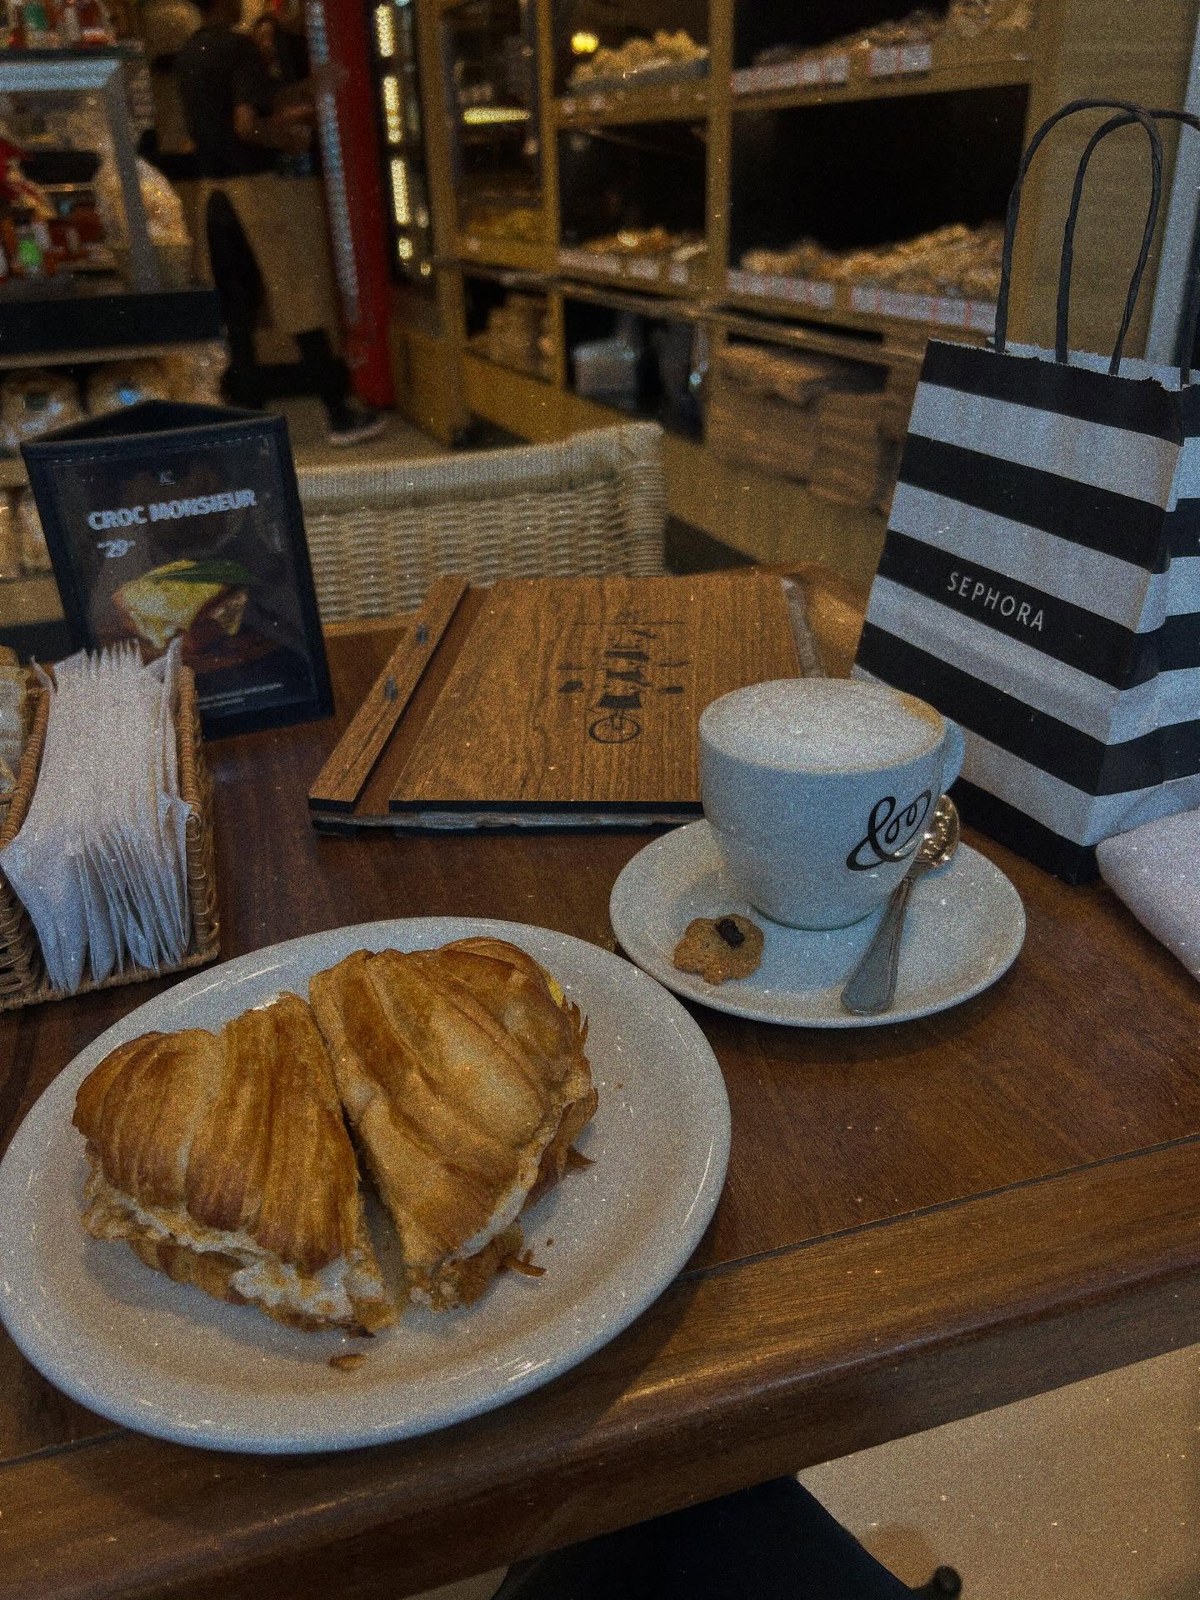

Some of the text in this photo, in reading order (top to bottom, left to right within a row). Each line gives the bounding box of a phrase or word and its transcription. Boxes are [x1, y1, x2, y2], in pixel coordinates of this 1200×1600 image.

[87, 488, 257, 530] CROC MONSIEUR
[947, 571, 1044, 632] SEPHORA
